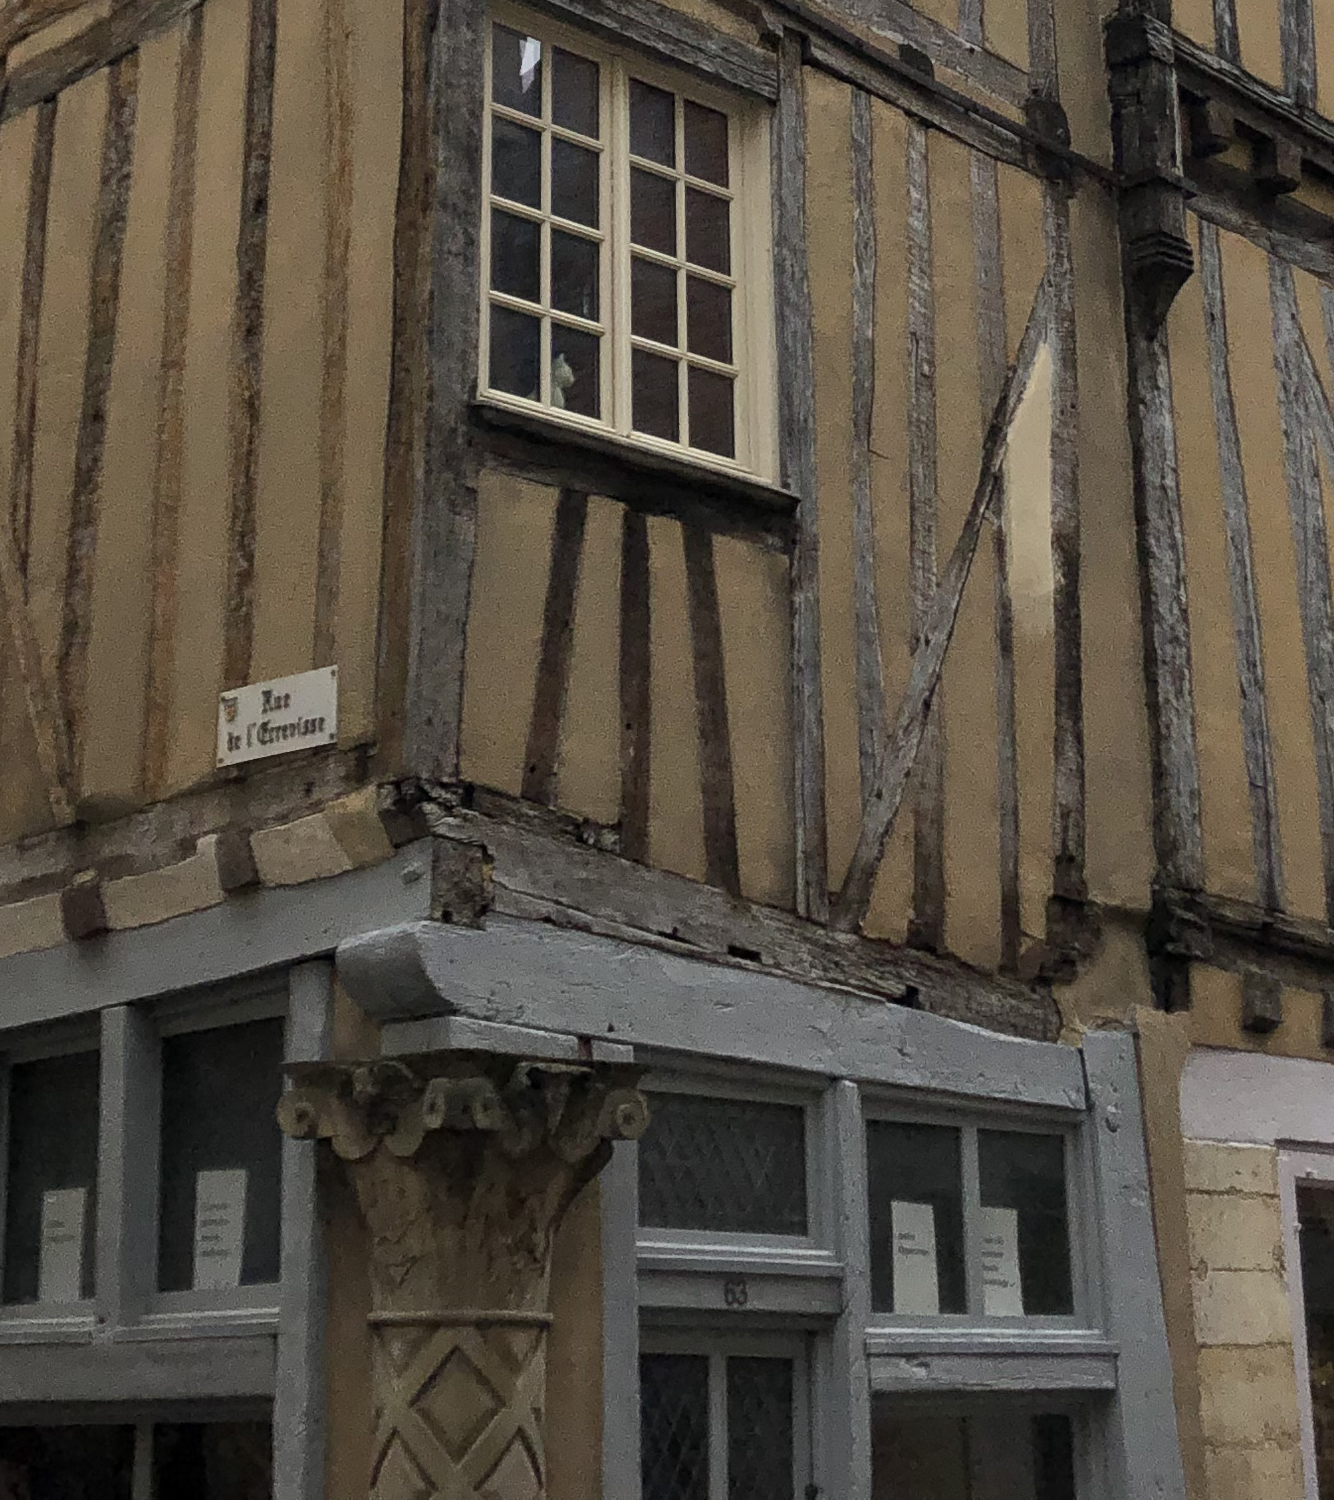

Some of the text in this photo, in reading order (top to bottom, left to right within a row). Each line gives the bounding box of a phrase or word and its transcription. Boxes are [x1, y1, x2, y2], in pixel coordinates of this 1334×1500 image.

[261, 689, 291, 714] Rue
[227, 731, 241, 753] de
[723, 1281, 748, 1306] 63
